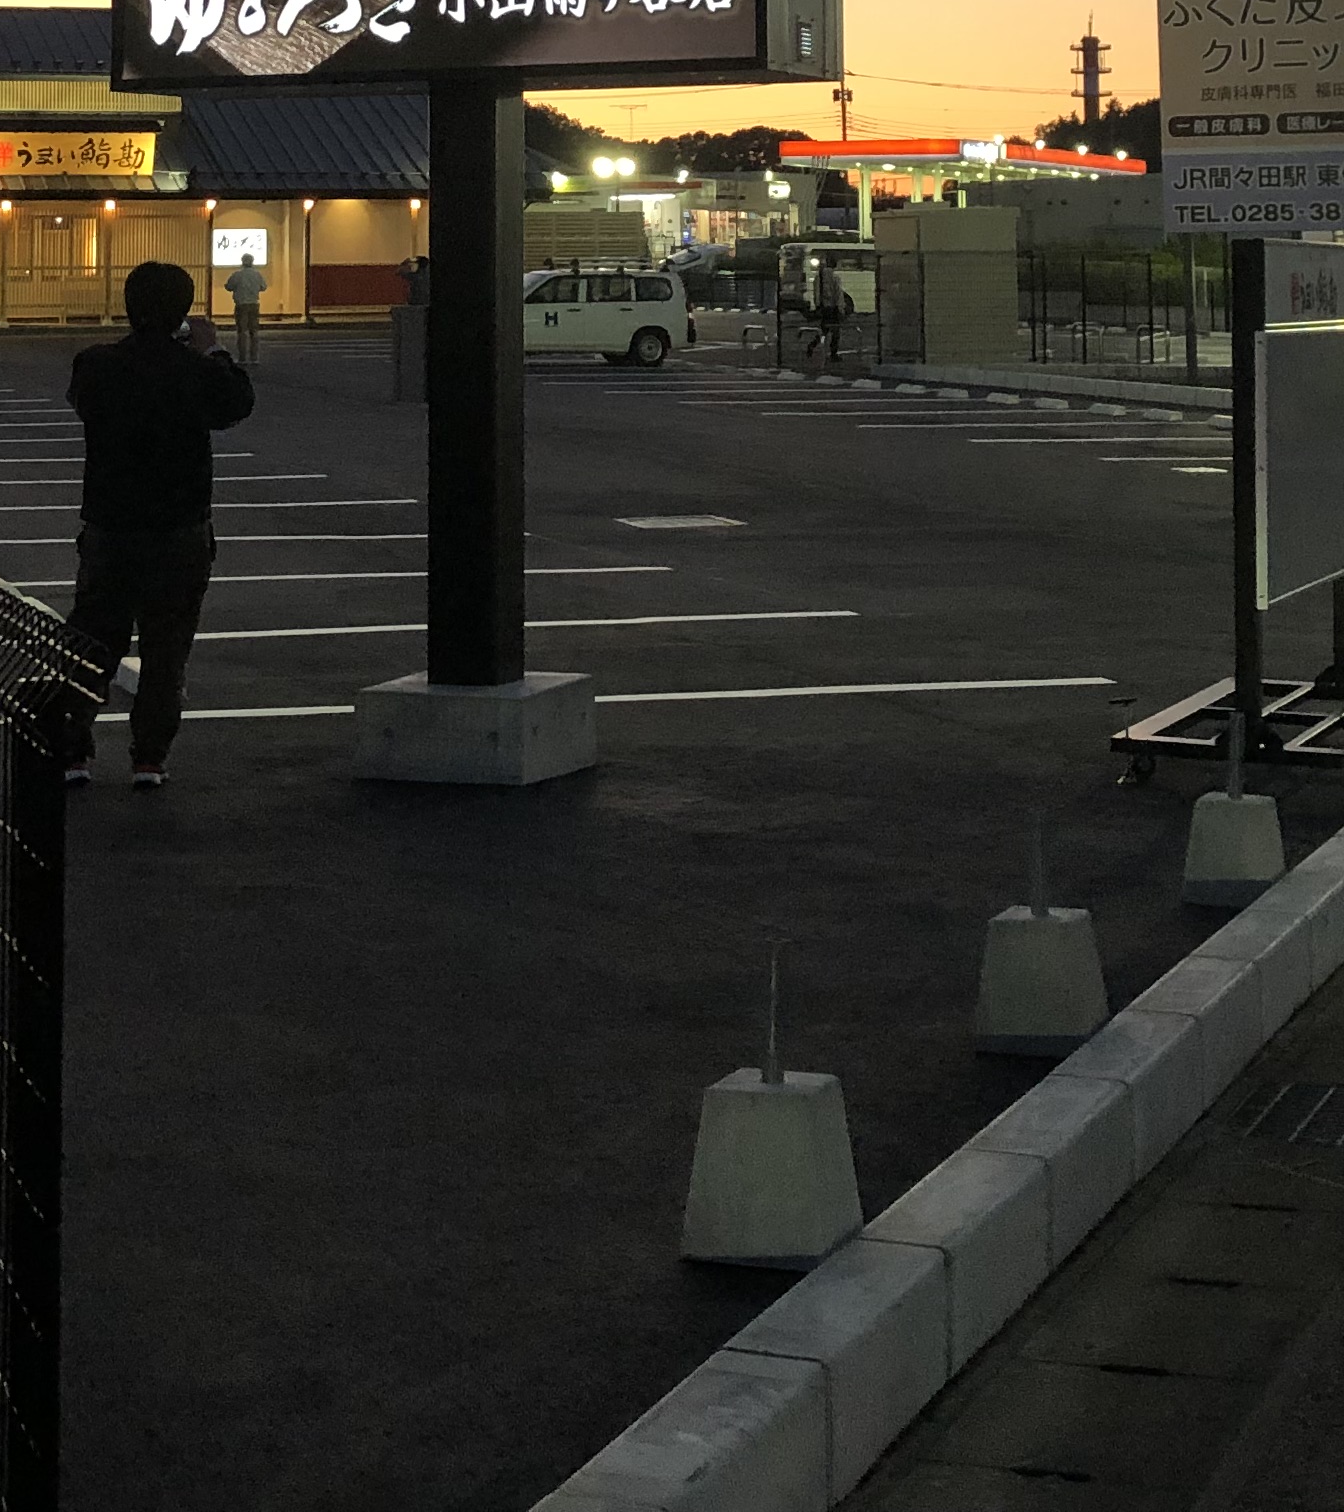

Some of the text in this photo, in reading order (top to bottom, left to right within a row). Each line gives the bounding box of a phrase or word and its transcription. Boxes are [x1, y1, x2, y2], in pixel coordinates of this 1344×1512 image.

[1200, 85, 1298, 102] 皮膚科専門医
[17, 137, 147, 170] うまい鮨勘
[1172, 165, 1307, 191] JR間々田駅
